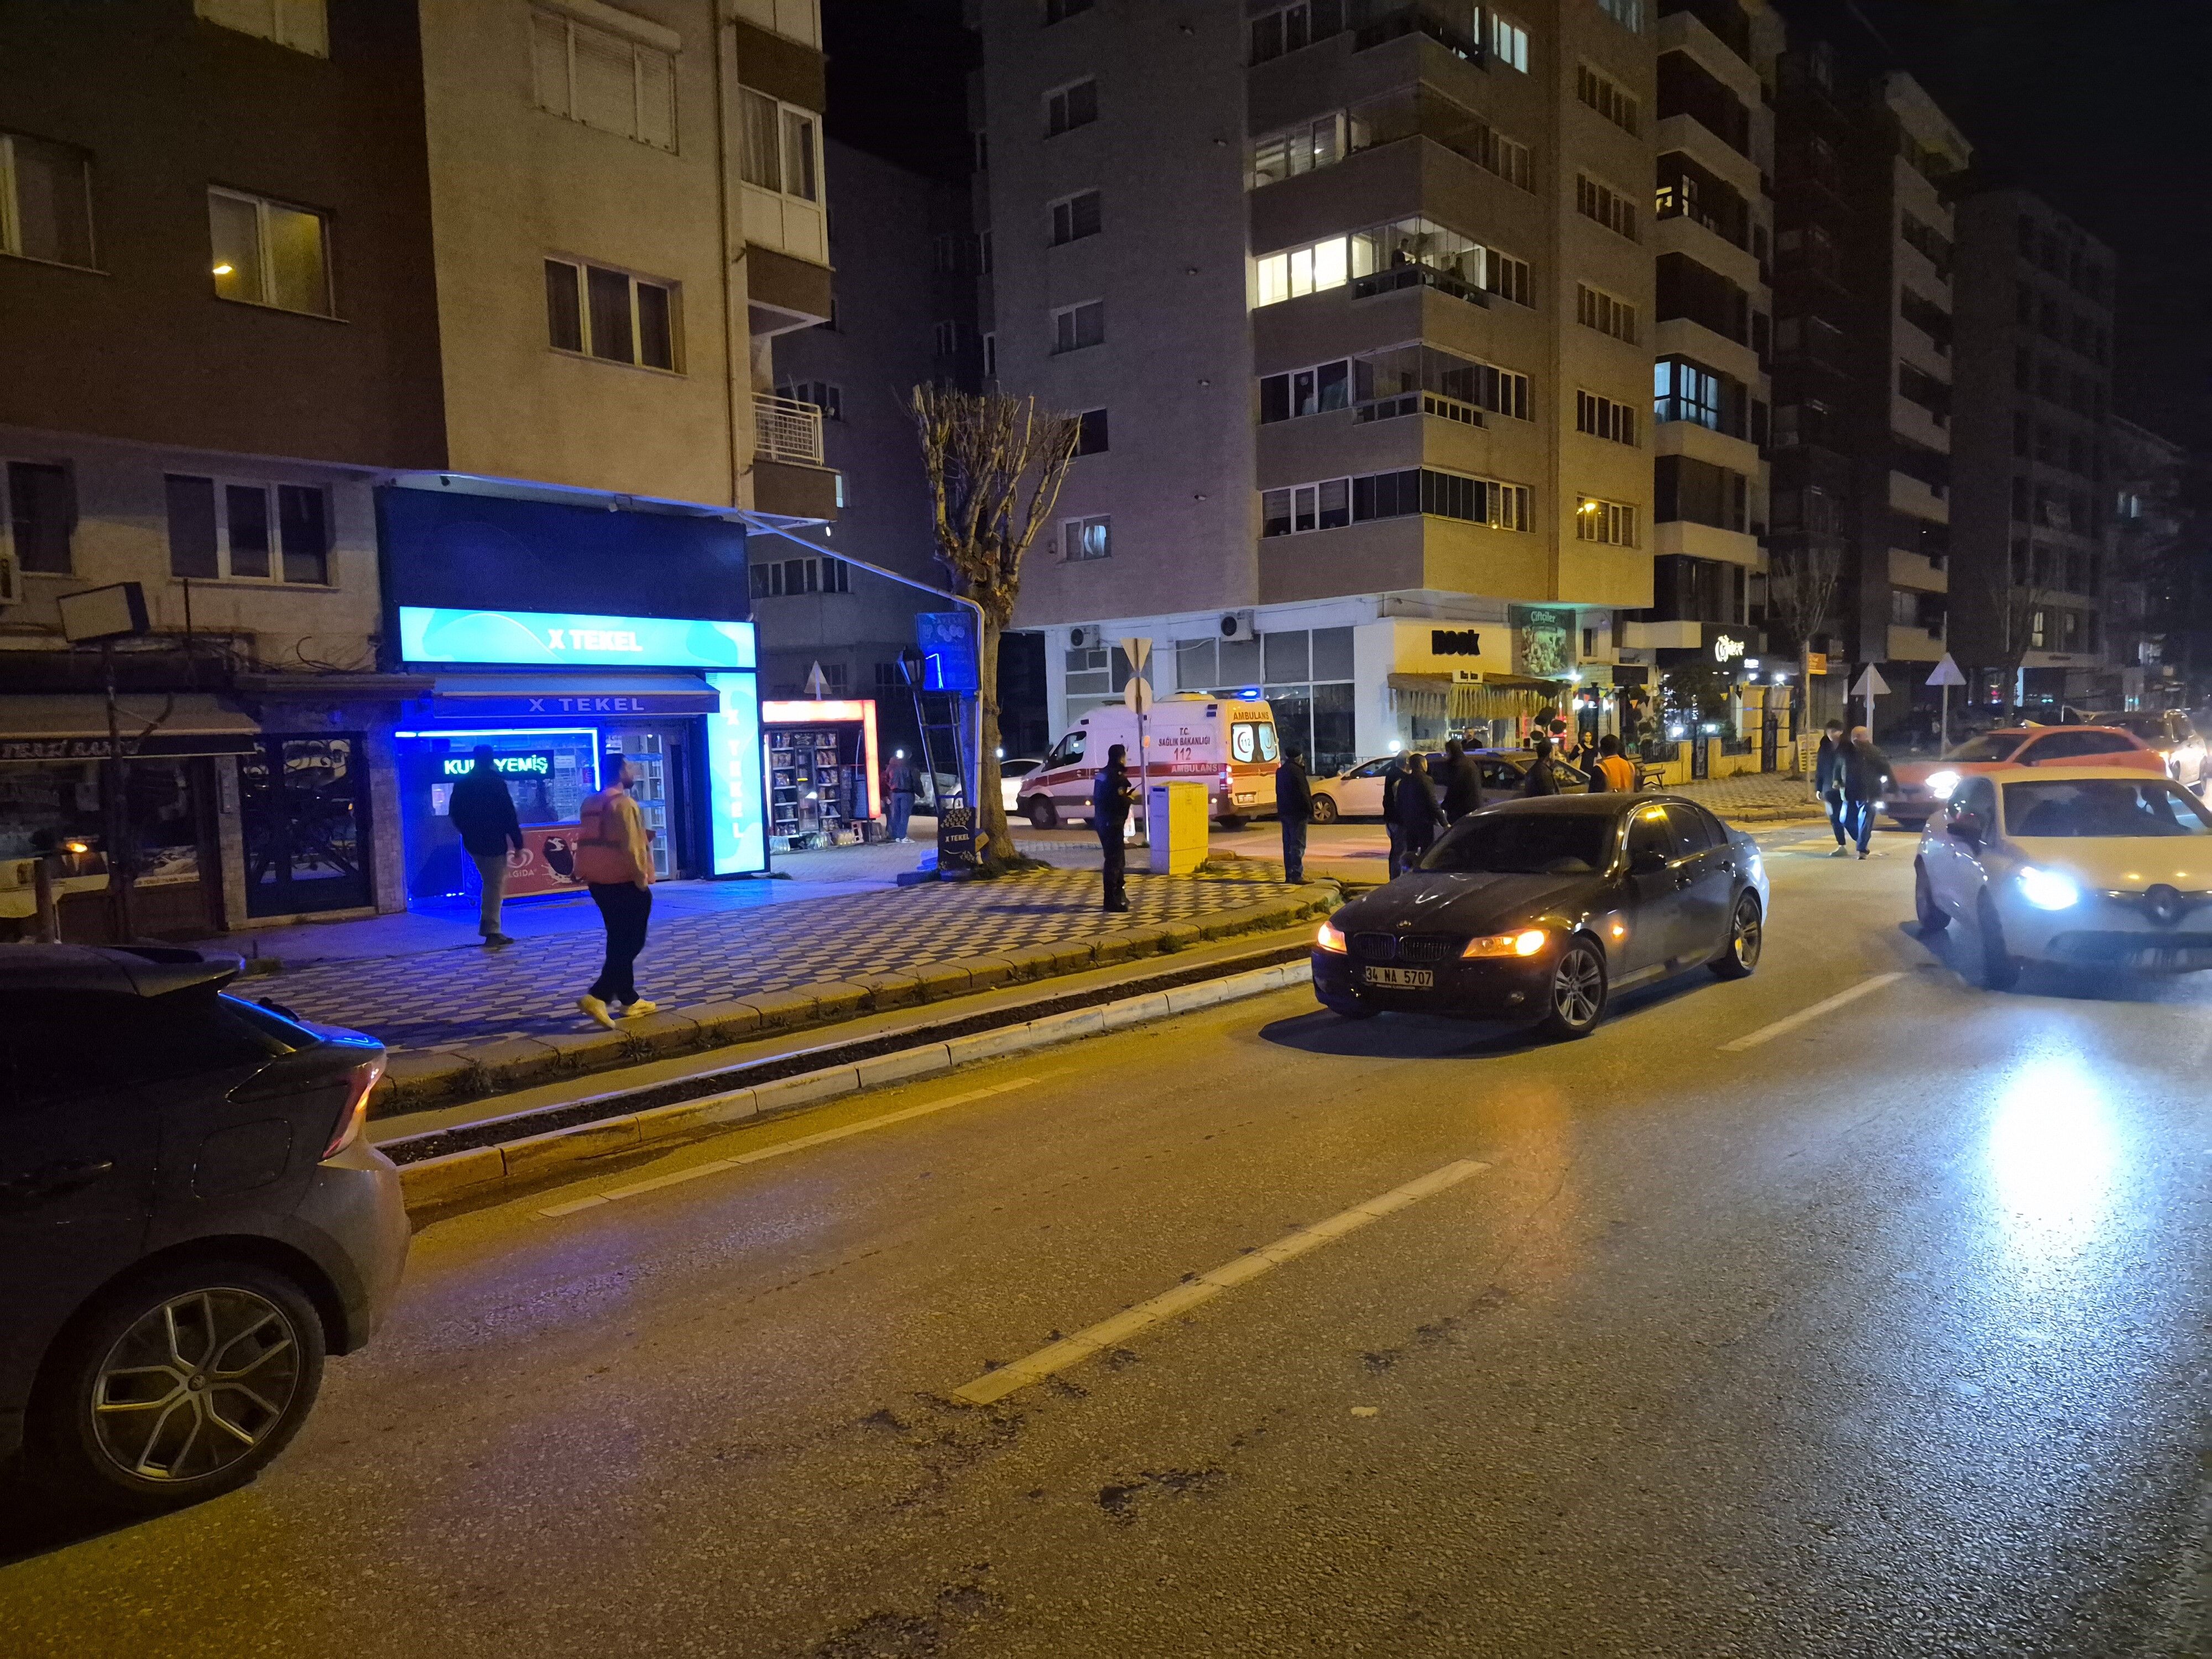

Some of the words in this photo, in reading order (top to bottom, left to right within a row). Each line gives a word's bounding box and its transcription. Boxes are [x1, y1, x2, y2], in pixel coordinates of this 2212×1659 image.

[548, 629, 566, 649] X
[568, 629, 643, 651] TEKEL
[529, 698, 545, 712] X
[558, 698, 644, 711] TEKEL
[727, 709, 739, 726] X
[1234, 712, 1269, 720] AMBULANS
[1159, 737, 1178, 747] SAĞLIK
[1180, 735, 1211, 745] BAKANLIĞI
[1241, 738, 1250, 747] 112
[1174, 747, 1191, 760] 112
[445, 755, 548, 774] KUYEMİŞ
[1171, 764, 1218, 773] AMBULANS
[727, 740, 743, 838] TEKEL
[508, 869, 535, 878] LGIDA
[1366, 968, 1378, 981] 34
[1384, 969, 1397, 983] NA
[1404, 971, 1431, 985] 5707
